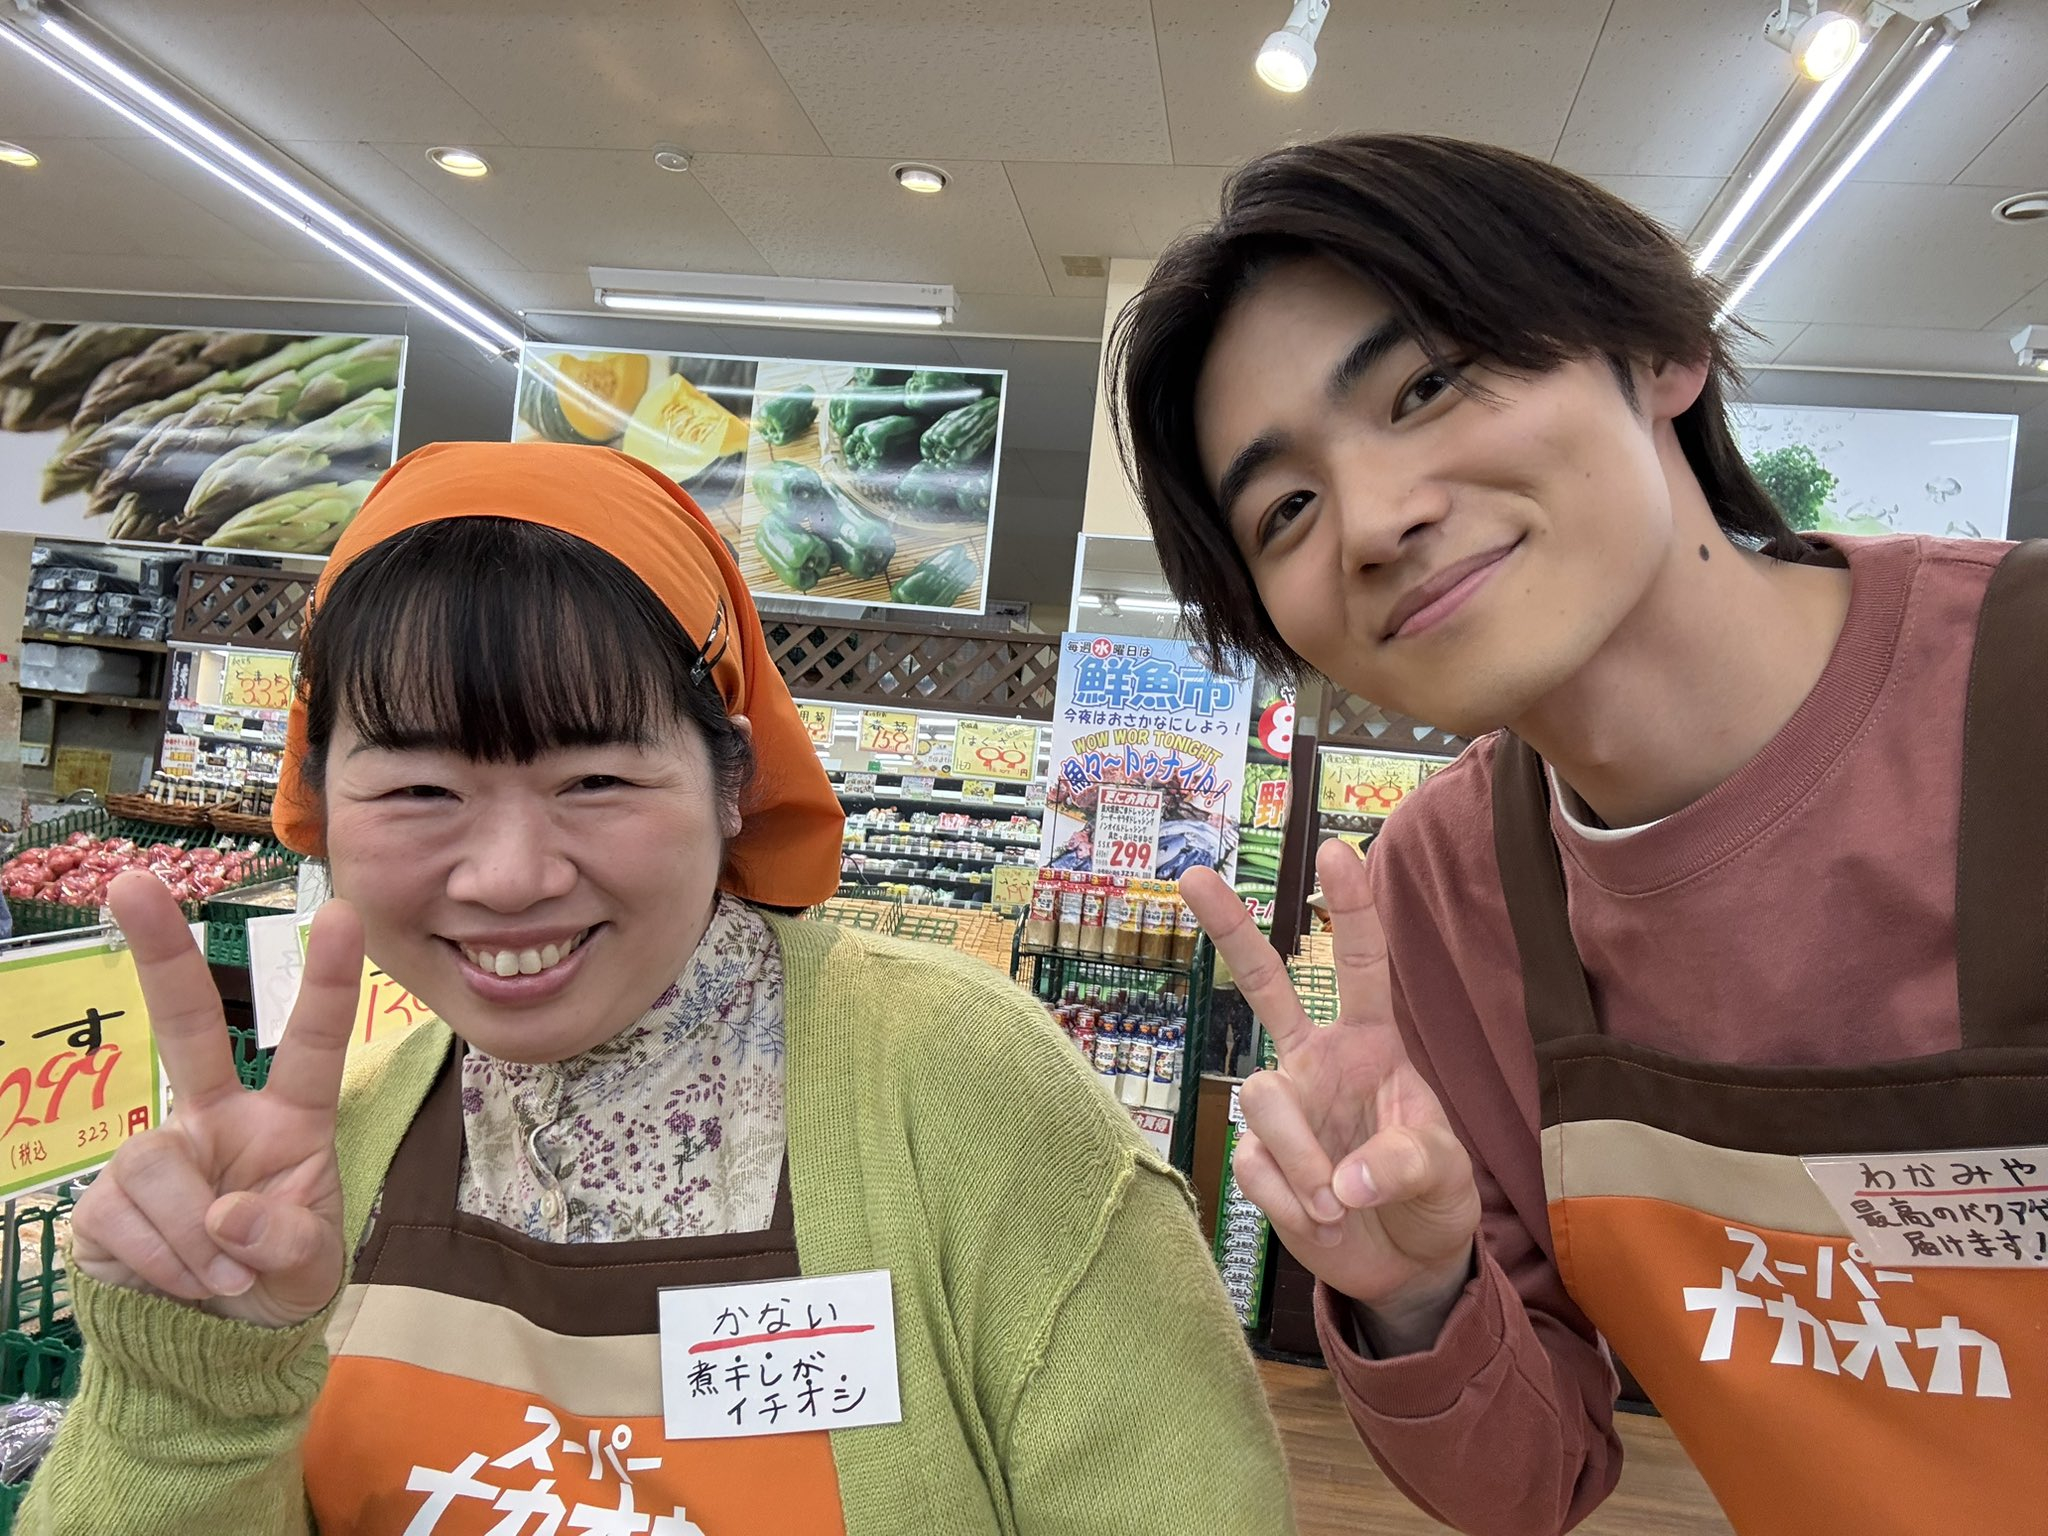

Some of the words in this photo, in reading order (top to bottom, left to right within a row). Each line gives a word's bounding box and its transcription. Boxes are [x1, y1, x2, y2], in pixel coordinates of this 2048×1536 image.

[1067, 637, 1151, 660] 毎週水曜日は
[1072, 657, 1235, 716] 鮮魚市
[961, 735, 1027, 750] はくさい
[1072, 731, 1110, 756] WOW
[1113, 728, 1150, 746] WOR
[1153, 730, 1224, 765] TONIGHT
[1109, 840, 1152, 869] 299
[0, 1044, 123, 1142] 299
[1859, 1158, 2037, 1189] わかみや
[1724, 1226, 1914, 1300] スーパー
[713, 1297, 837, 1335] かない
[1682, 1266, 2012, 1399] ナカオカ
[687, 1351, 825, 1397] 煮干しが
[728, 1380, 866, 1425] イチオシ
[488, 1405, 663, 1485] スーパー
